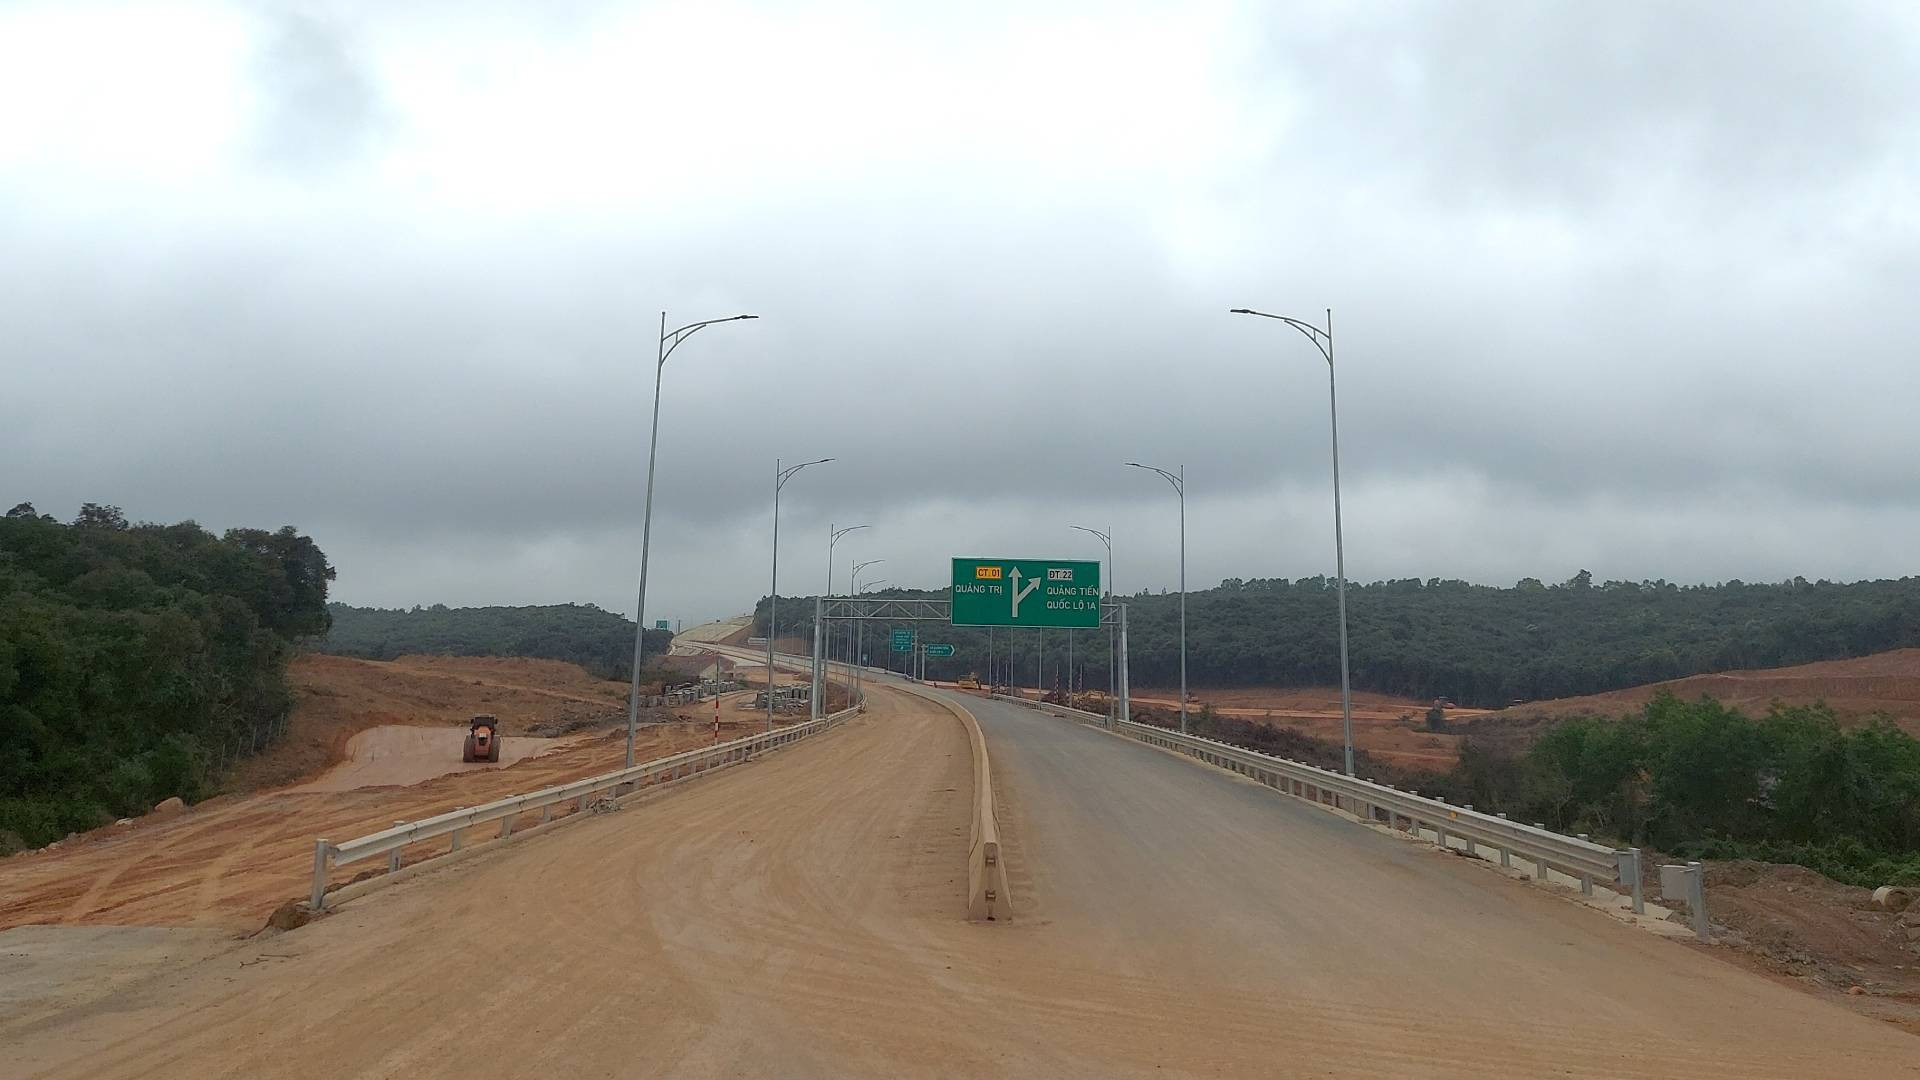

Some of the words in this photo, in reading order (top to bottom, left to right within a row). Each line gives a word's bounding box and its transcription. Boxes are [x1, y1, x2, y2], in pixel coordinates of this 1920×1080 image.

[955, 582, 986, 593] QUẢNG
[988, 585, 1003, 596] TRỊ
[1047, 584, 1077, 596] QUẢNG
[1047, 598, 1071, 609] QUỐC
[1073, 599, 1084, 611] LỘ
[1087, 601, 1097, 610] 1A
